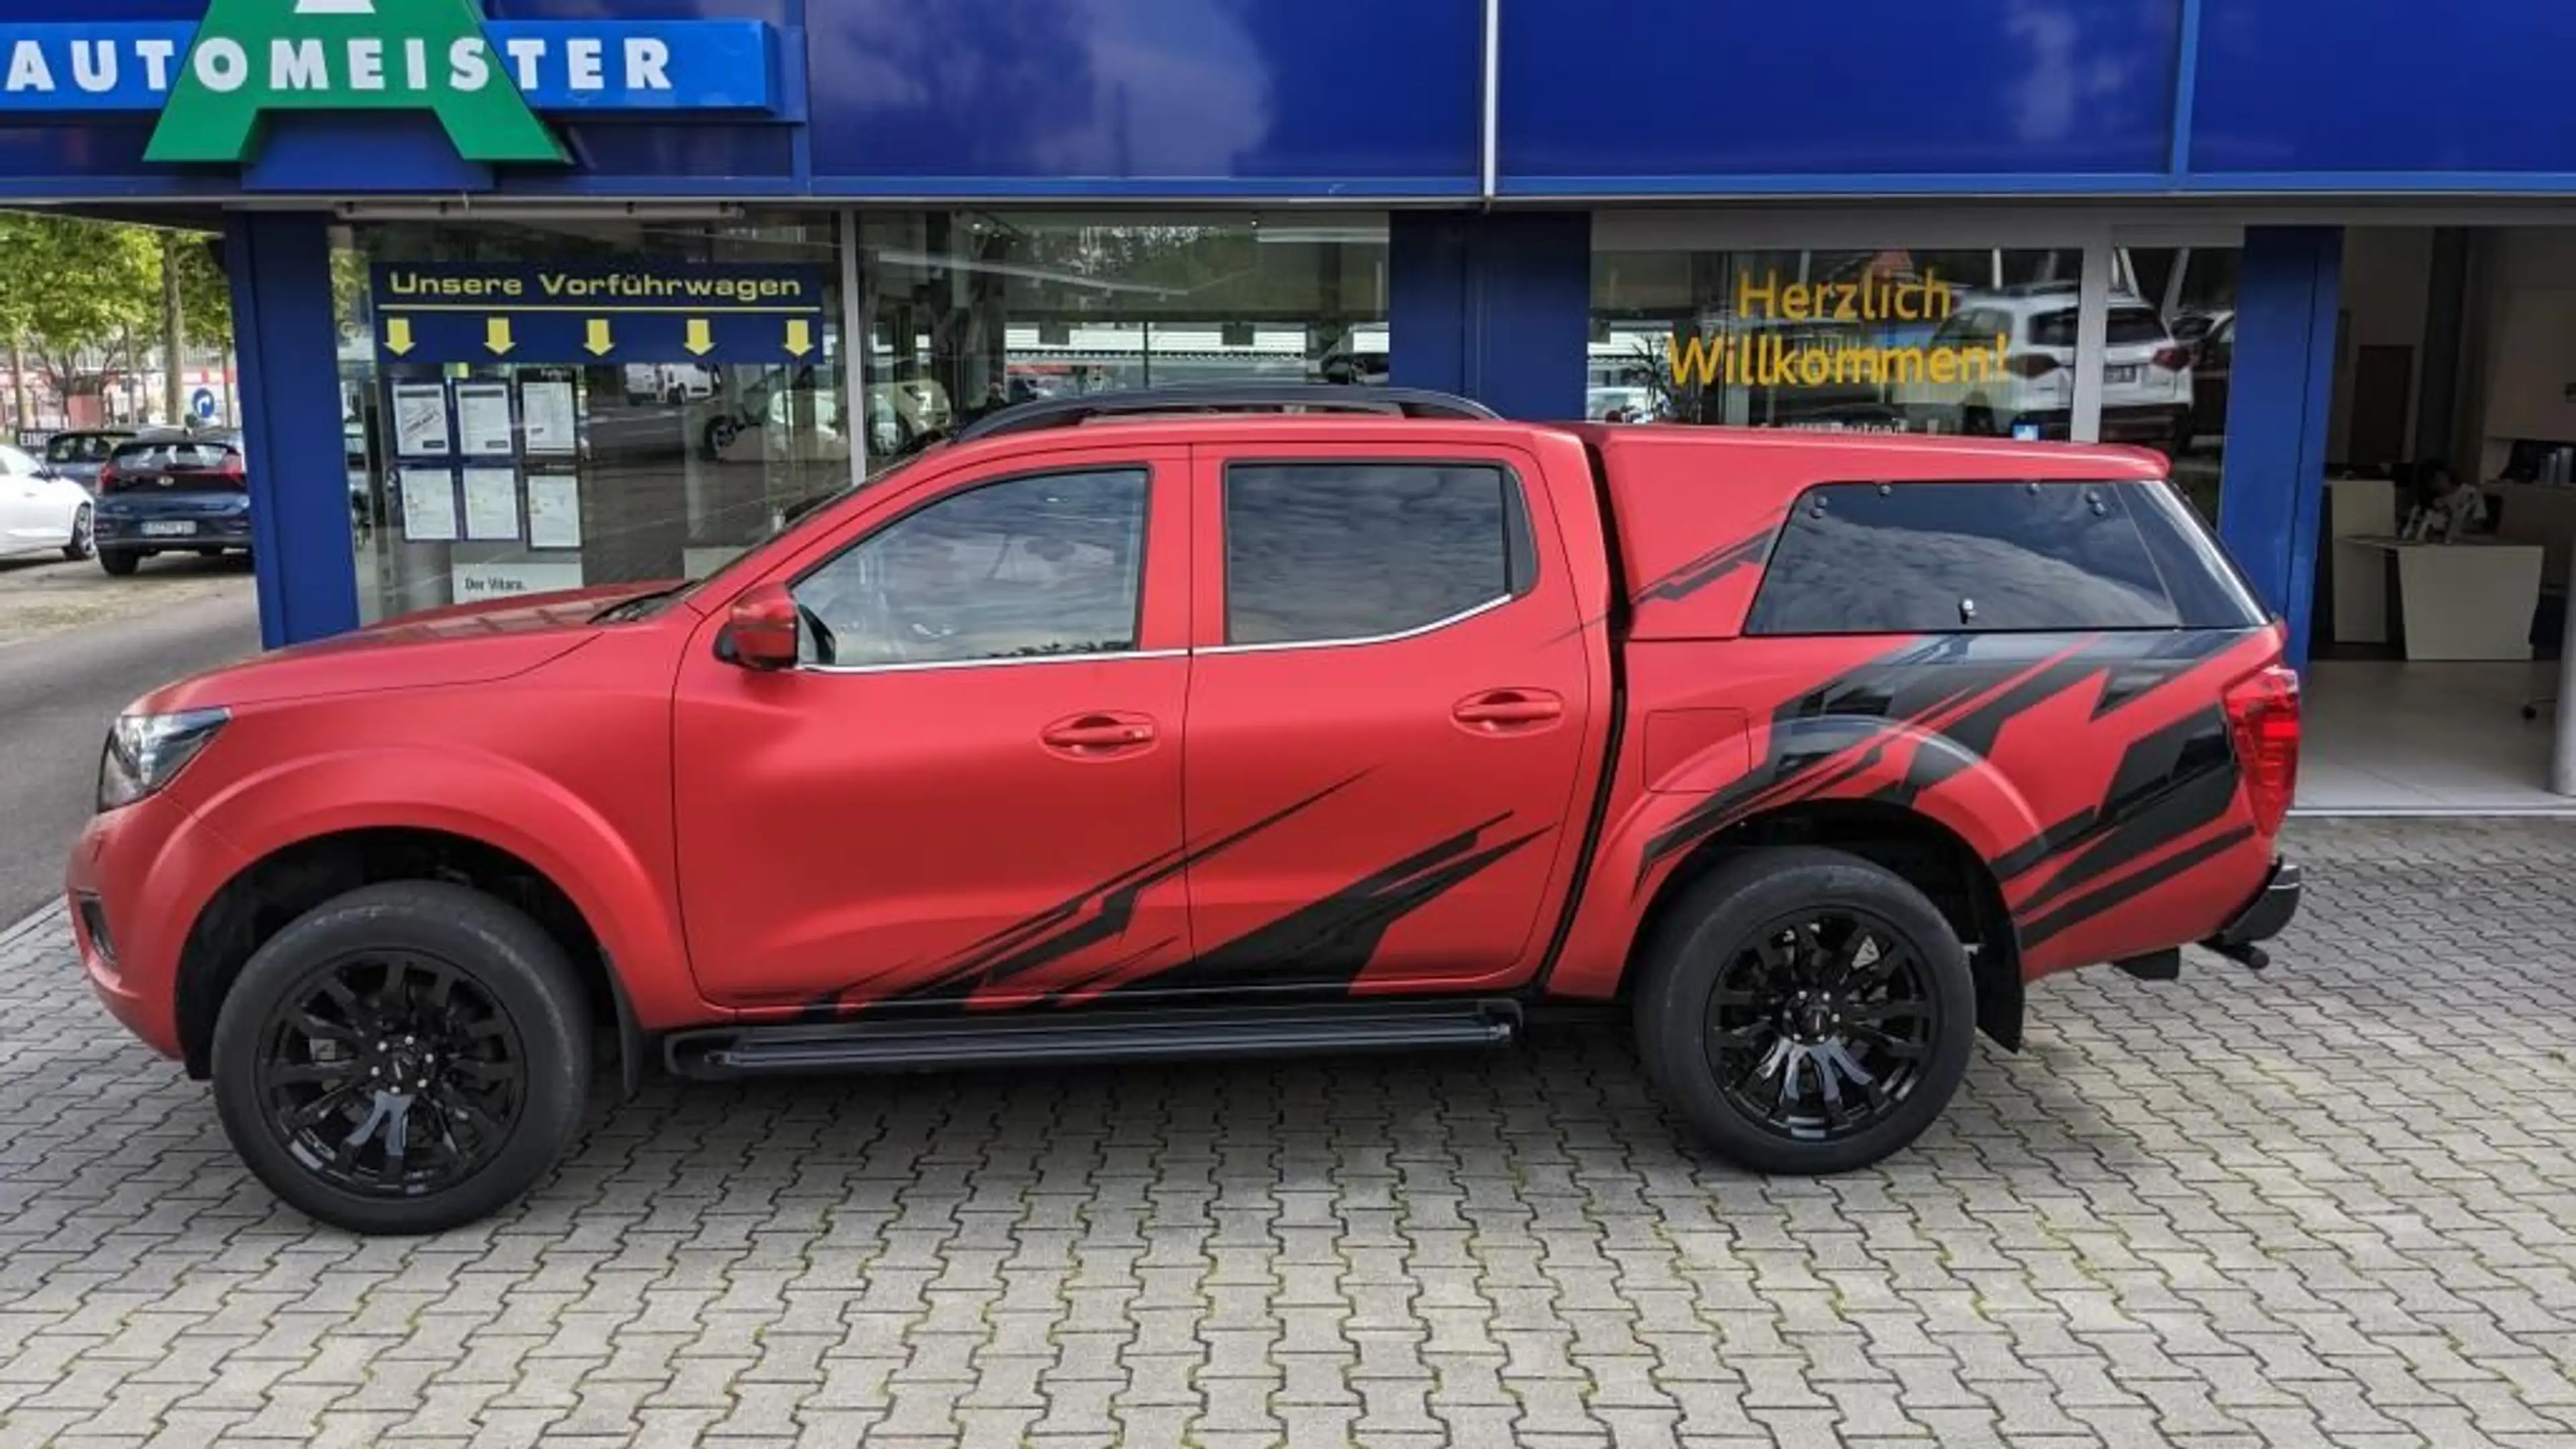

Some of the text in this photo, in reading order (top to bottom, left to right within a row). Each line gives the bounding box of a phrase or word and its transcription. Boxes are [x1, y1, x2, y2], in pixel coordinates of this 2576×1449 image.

[5, 37, 673, 93] AUTOMEISTER
[390, 271, 802, 303] Unsere Vorführwagen
[1737, 268, 1952, 321] Herzlich
[1668, 331, 2010, 387] Willkommen!
